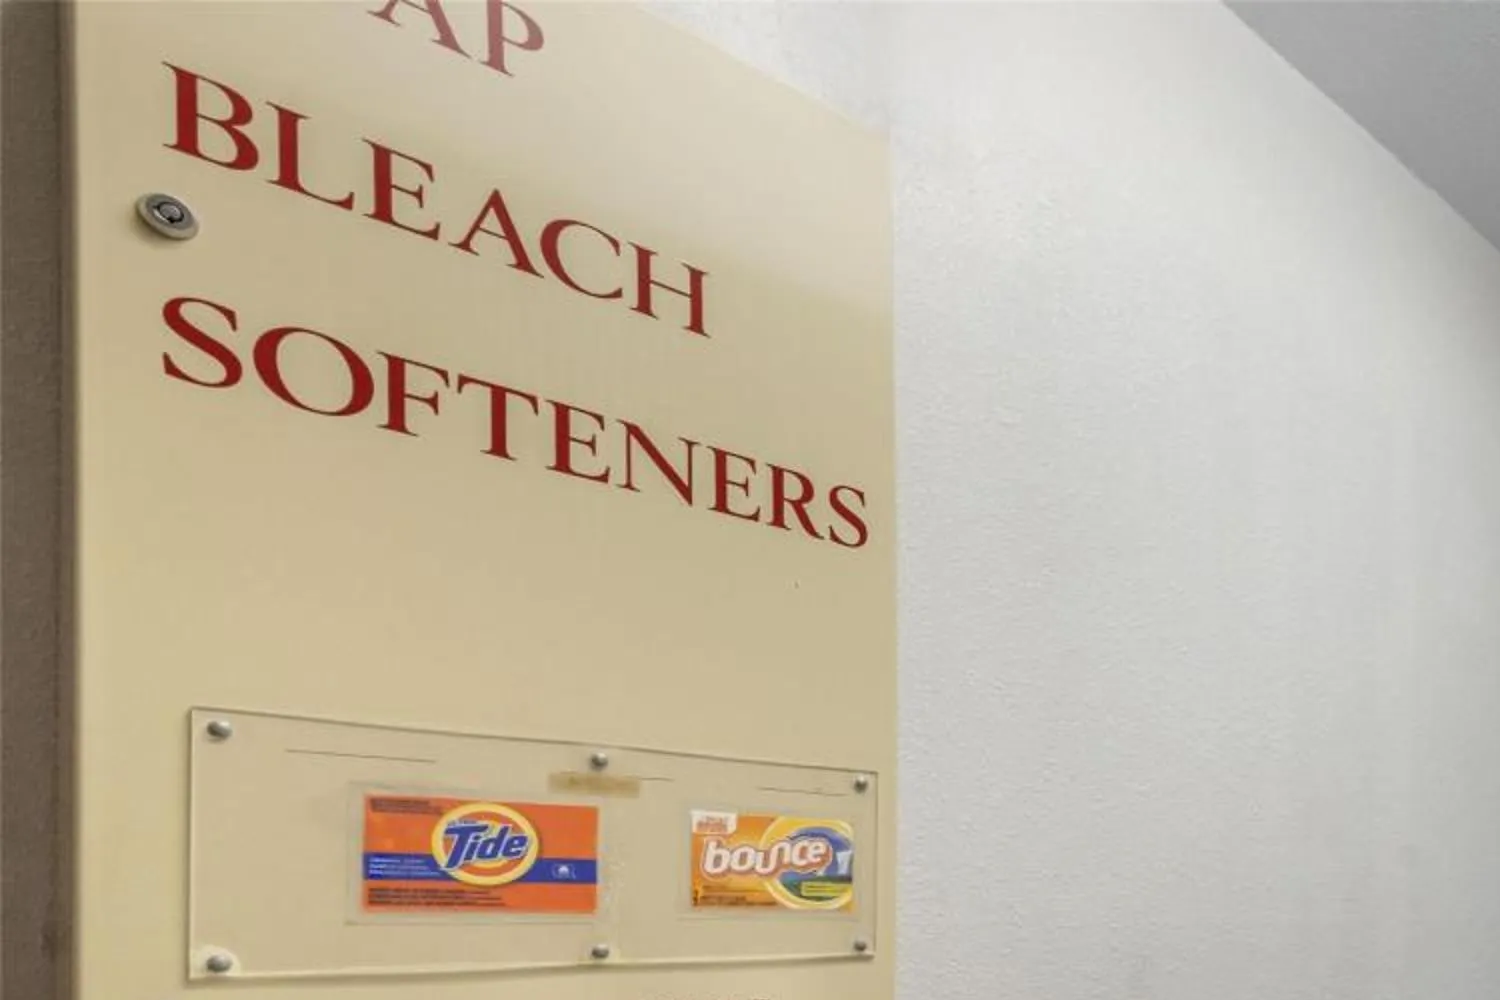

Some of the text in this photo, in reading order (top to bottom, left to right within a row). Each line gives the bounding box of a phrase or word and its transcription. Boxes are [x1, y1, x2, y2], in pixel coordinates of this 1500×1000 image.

[163, 62, 711, 337] BLEACH
[161, 296, 869, 548] SOFTENERS
[441, 822, 529, 869] Tide
[703, 836, 829, 876] bounce
